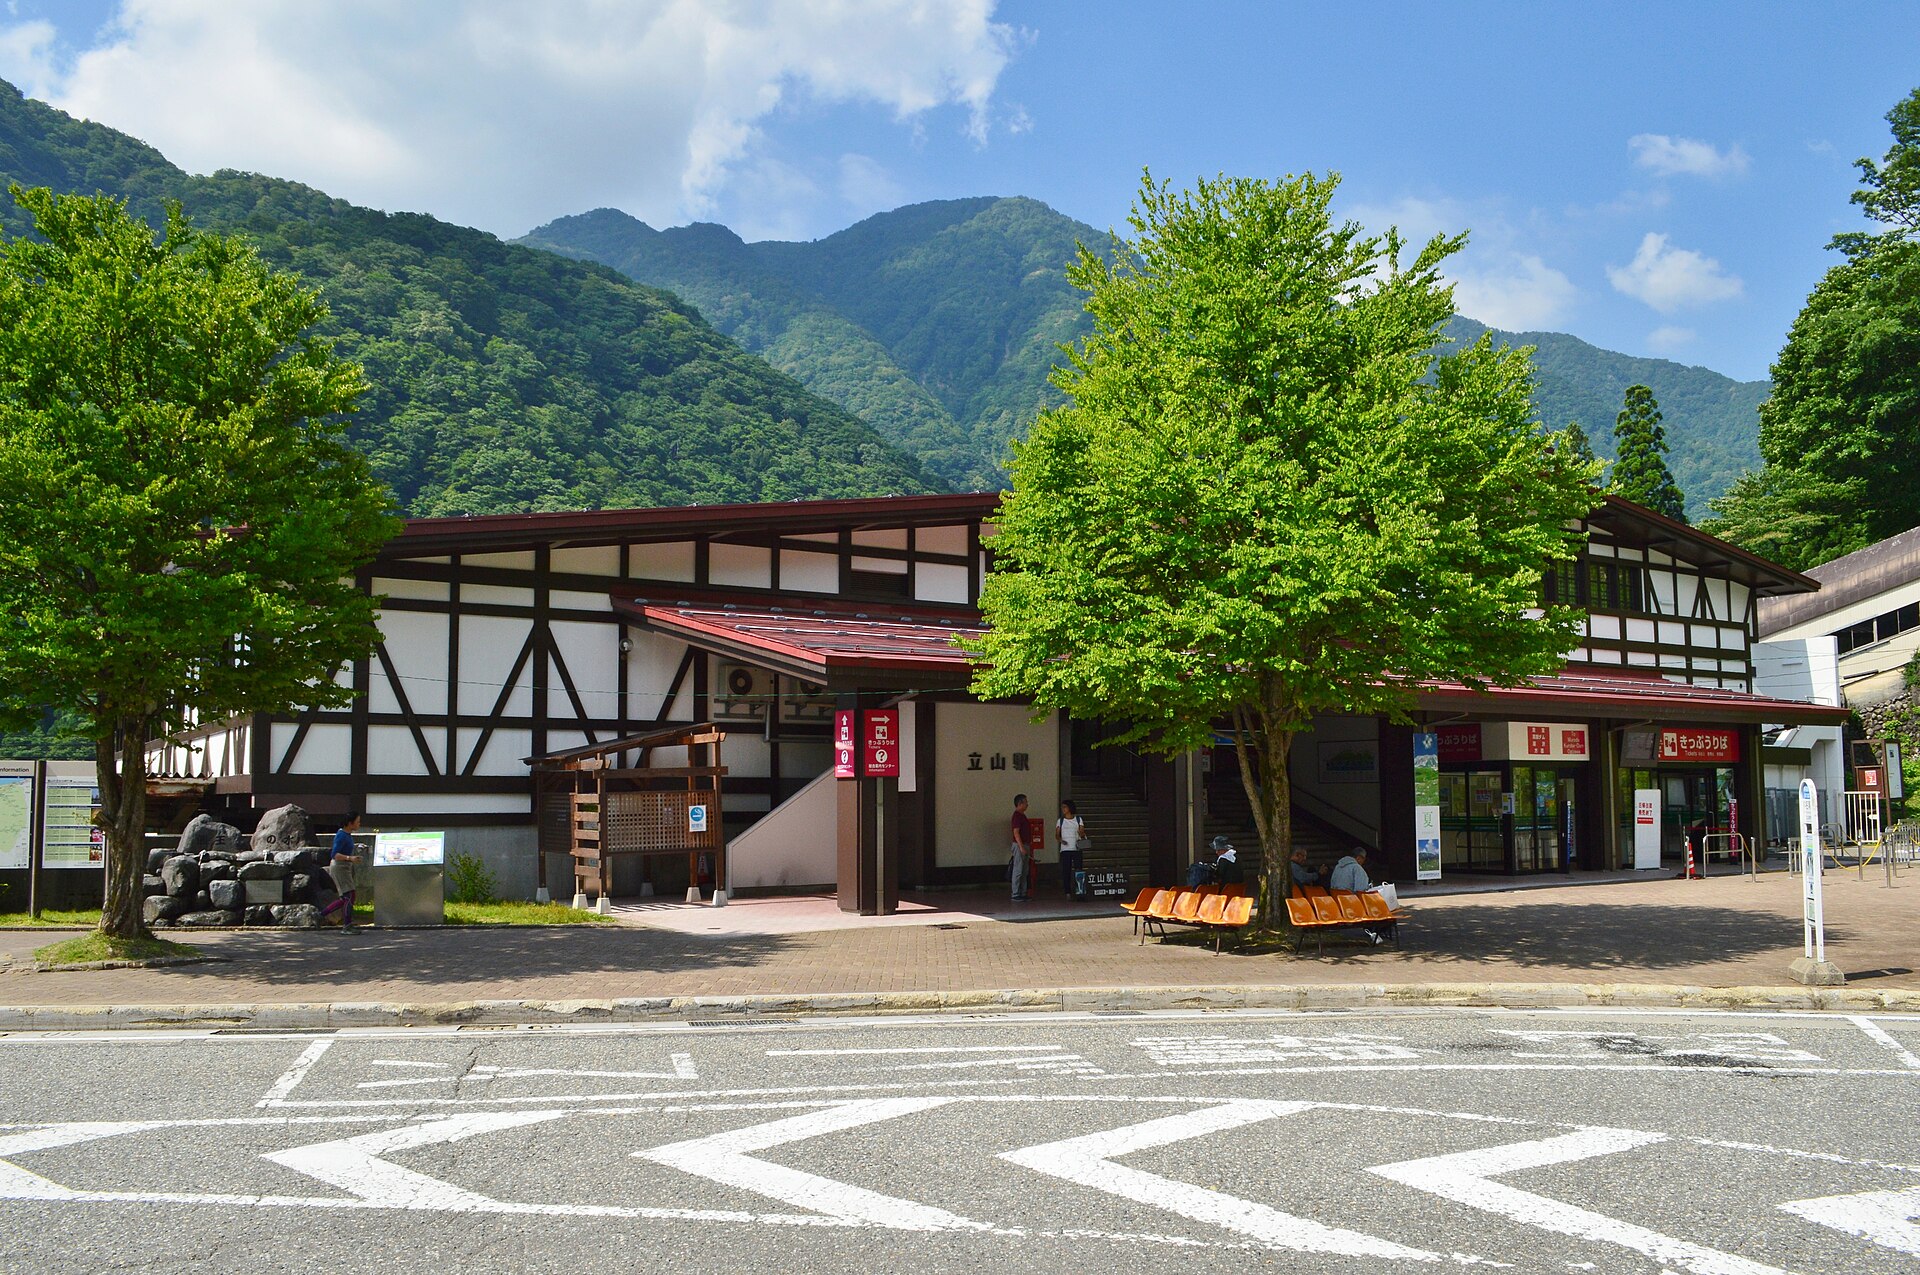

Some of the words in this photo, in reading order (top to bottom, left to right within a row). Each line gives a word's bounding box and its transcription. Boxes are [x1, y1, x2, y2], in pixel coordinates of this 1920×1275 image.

[1438, 734, 1477, 745] っぷうりば
[1679, 734, 1728, 750] きっぷうりば
[966, 751, 1031, 771] 立山駅
[1422, 811, 1433, 828] 夏
[1087, 873, 1115, 883] 立山駅
